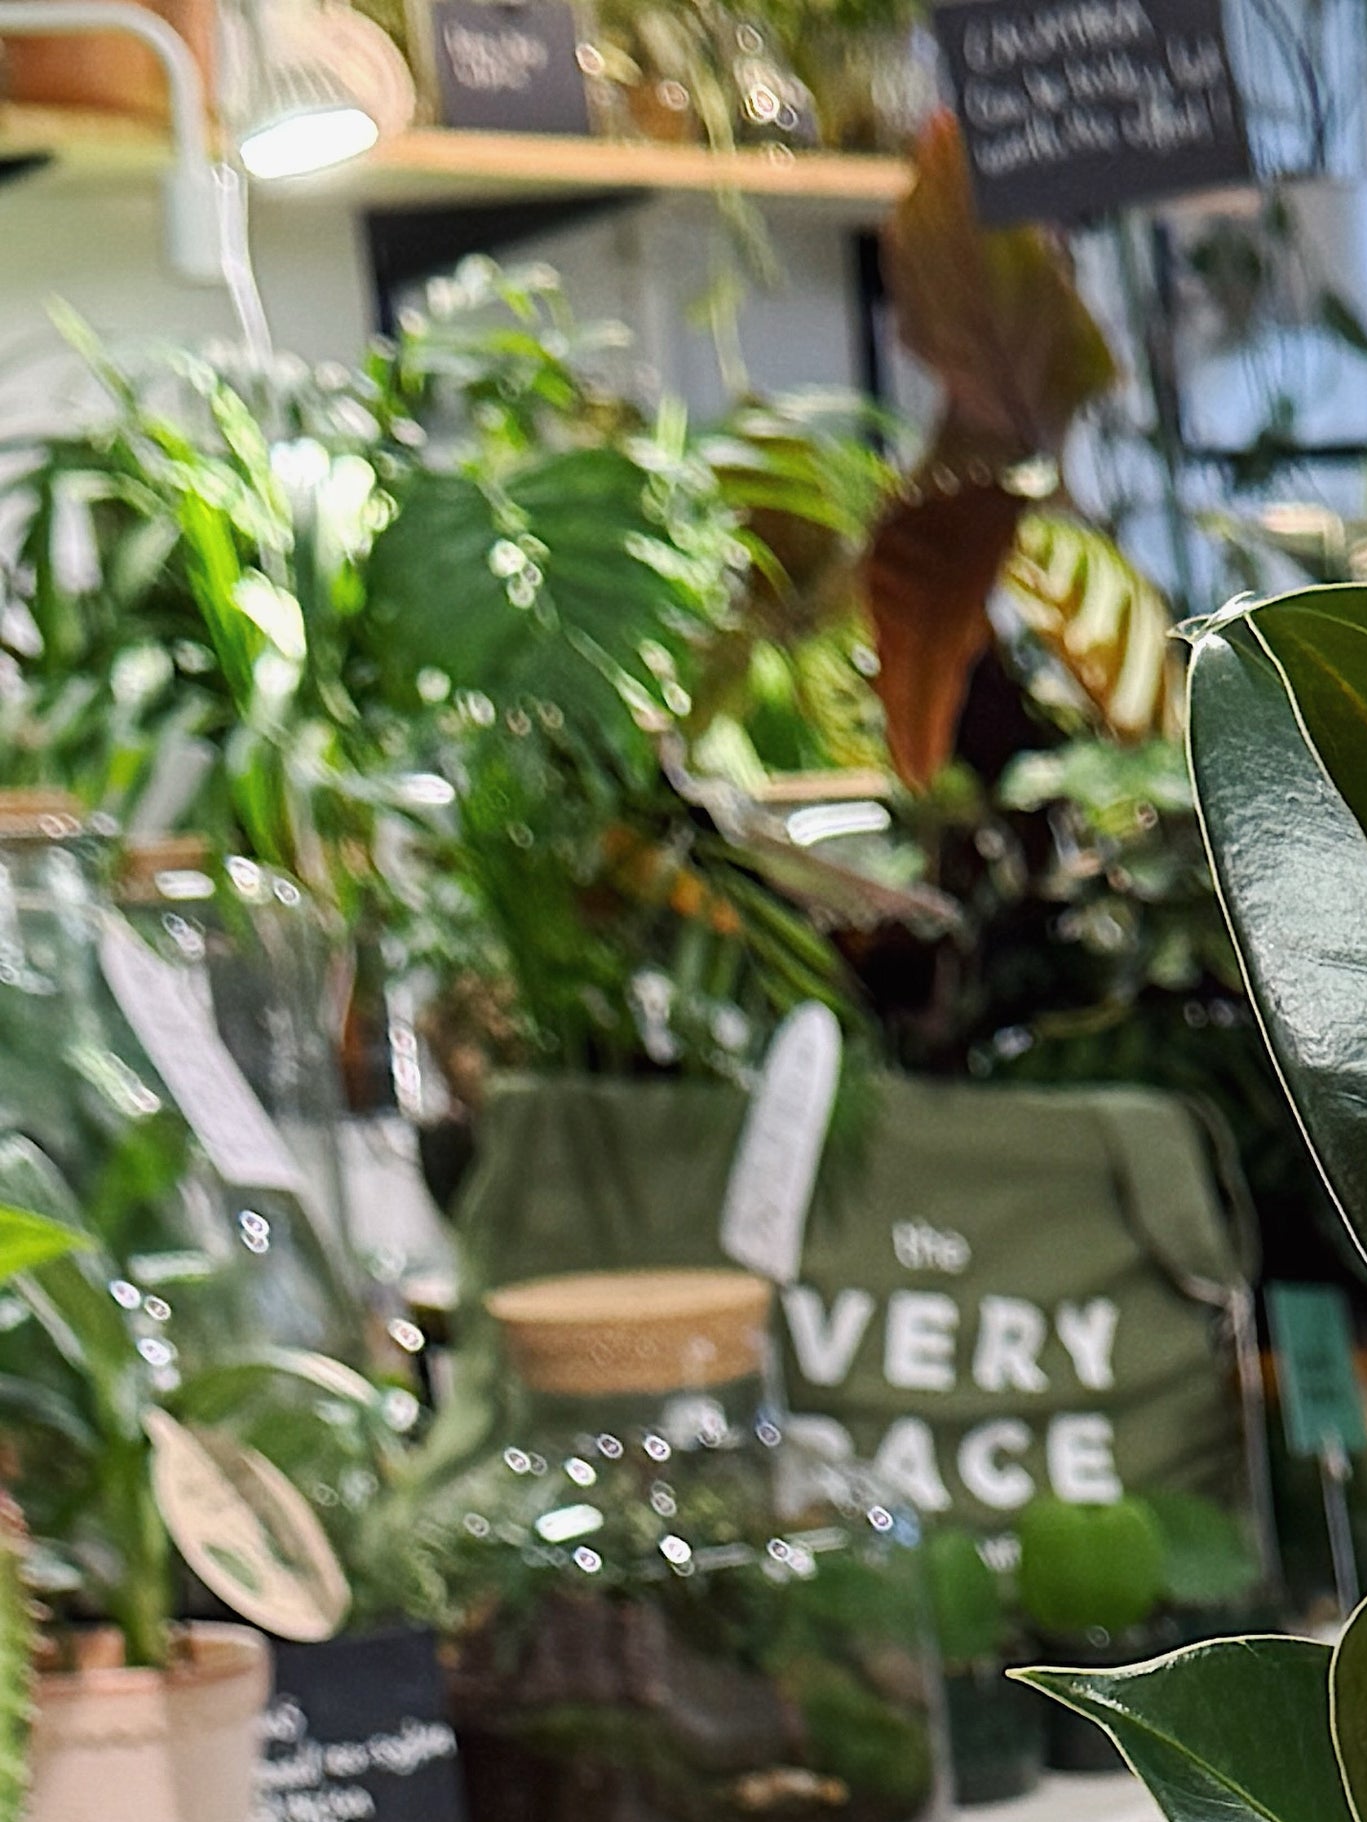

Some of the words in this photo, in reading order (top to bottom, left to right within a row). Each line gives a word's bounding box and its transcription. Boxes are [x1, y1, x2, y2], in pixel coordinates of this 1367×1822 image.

[892, 1218, 972, 1275] the
[782, 1286, 1120, 1390] VERY
[775, 1411, 1124, 1520] PACE
